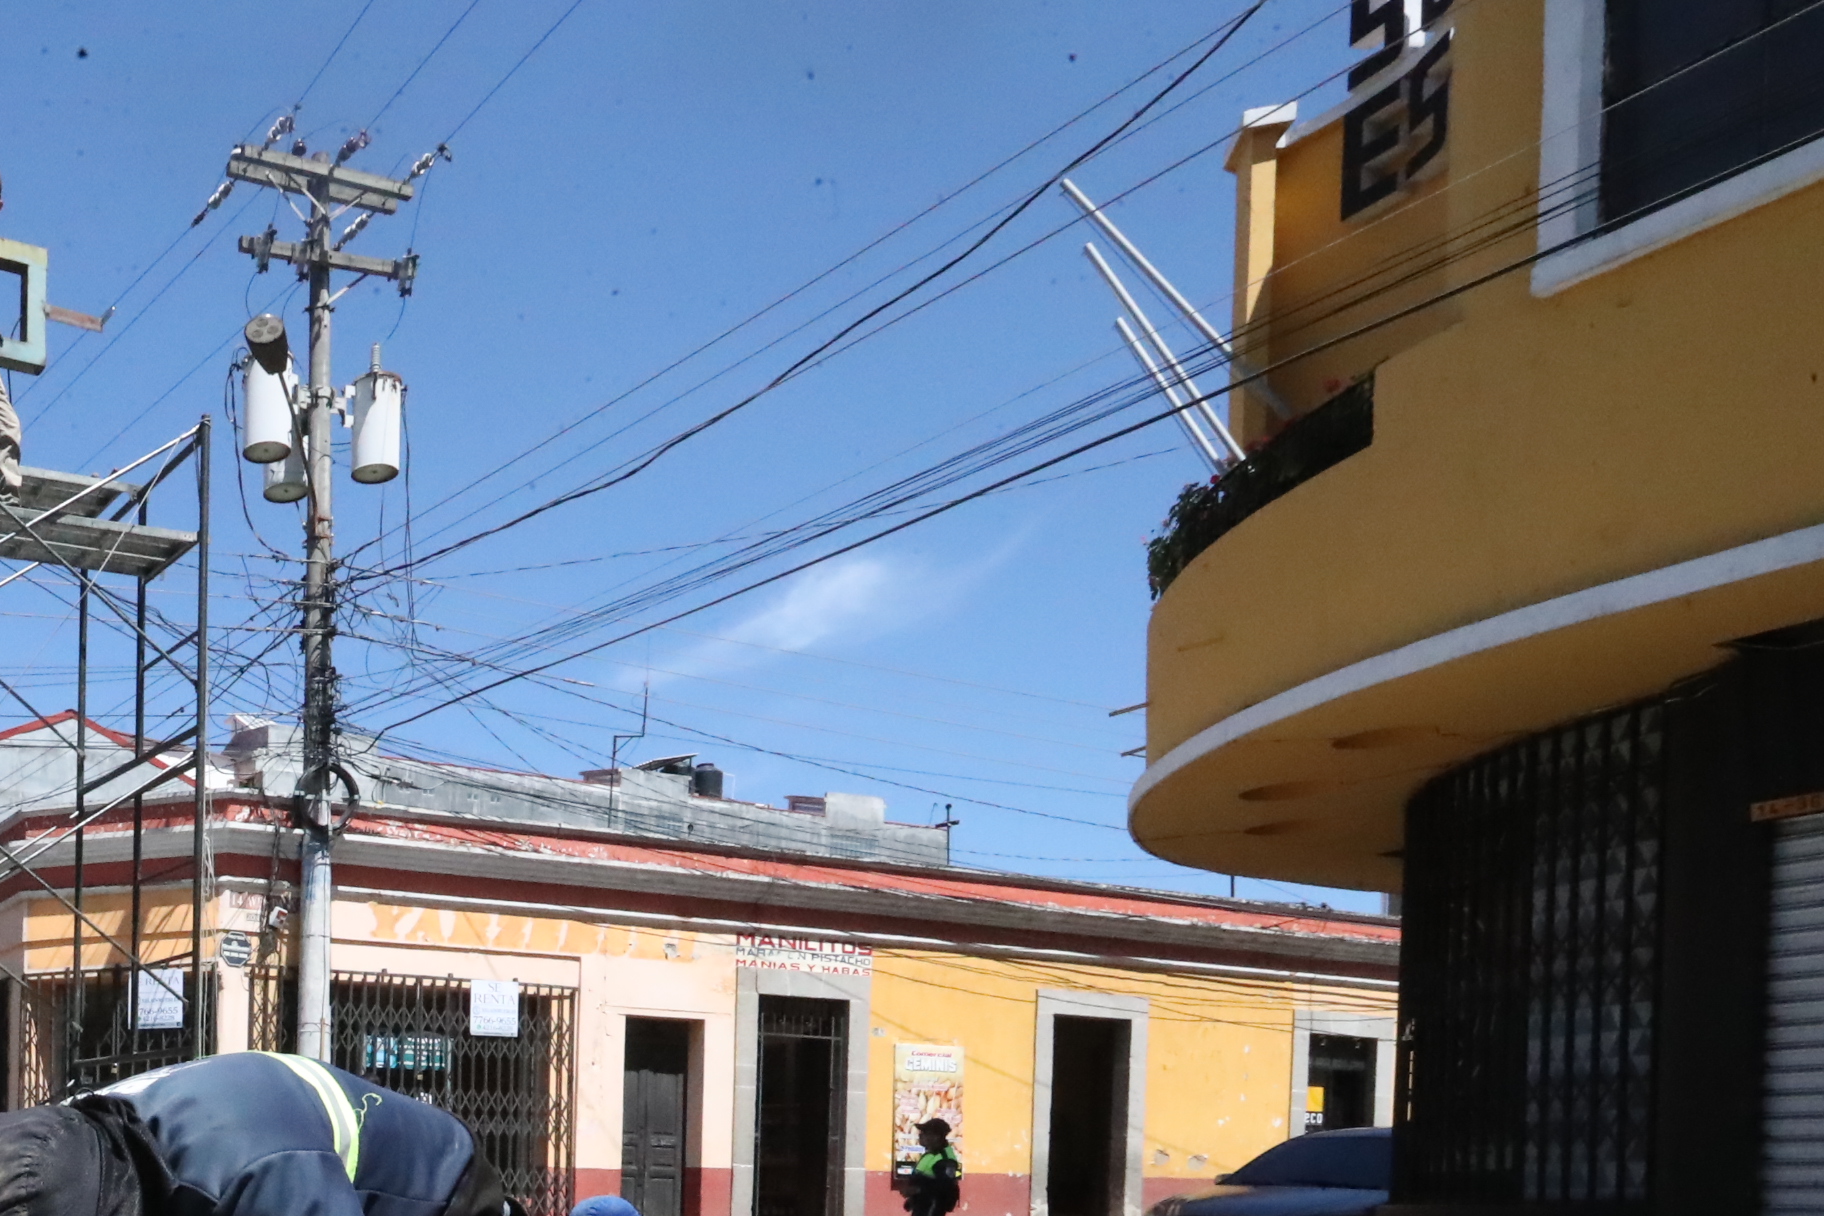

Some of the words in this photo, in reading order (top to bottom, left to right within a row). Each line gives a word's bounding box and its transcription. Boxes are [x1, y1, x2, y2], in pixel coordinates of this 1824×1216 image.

[735, 932, 872, 956] MANILITOS
[811, 952, 871, 966] PISTACHO
[735, 958, 801, 972] MANIAS
[807, 963, 816, 972] Y
[821, 965, 872, 977] HABAS
[488, 983, 502, 993] SE
[473, 993, 516, 1006] RENTA
[139, 1006, 179, 1016] 766-9655
[905, 1057, 958, 1074] GEMINIS
